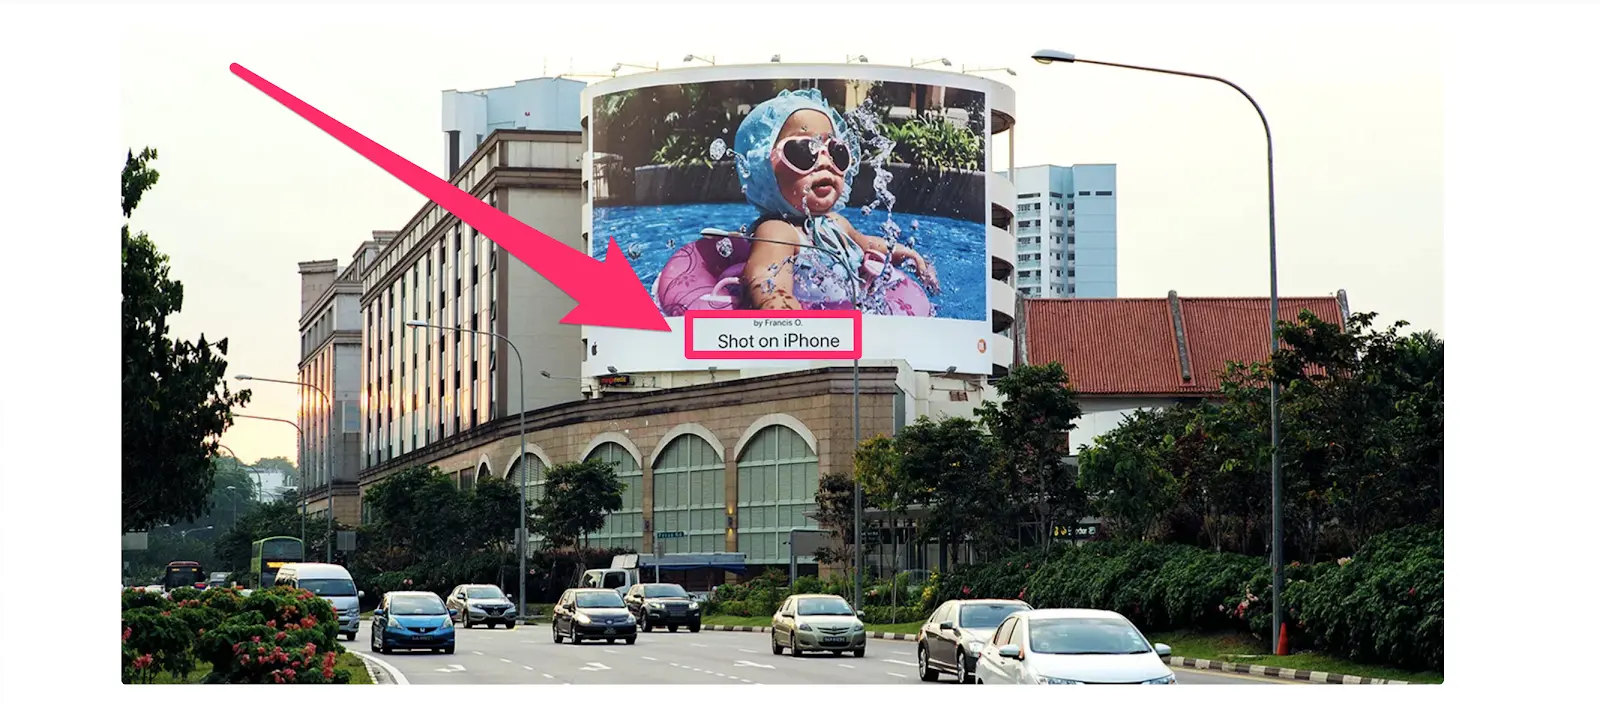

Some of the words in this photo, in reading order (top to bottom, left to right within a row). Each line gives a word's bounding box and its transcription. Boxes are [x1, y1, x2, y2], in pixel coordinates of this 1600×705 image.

[753, 319, 764, 328] by
[765, 318, 793, 327] Francis
[794, 318, 803, 327] O.
[717, 333, 754, 349] Shot
[759, 336, 779, 349] on
[784, 332, 840, 348] iPhone
